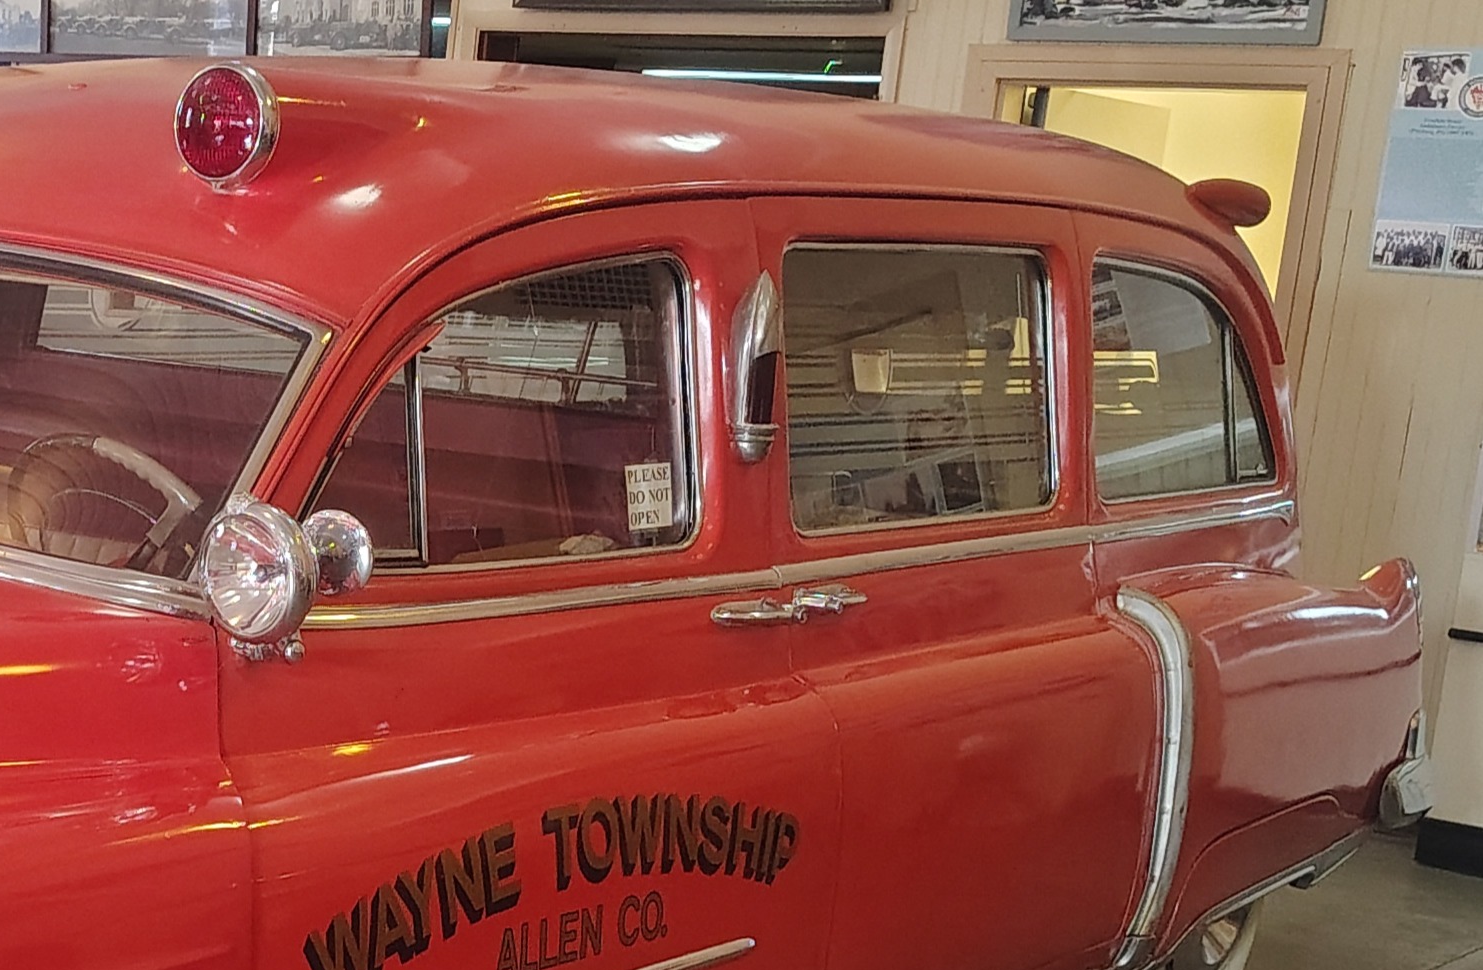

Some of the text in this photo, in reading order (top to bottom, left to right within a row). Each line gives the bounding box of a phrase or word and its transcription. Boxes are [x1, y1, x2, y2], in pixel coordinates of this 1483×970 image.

[627, 465, 670, 484] PLEASE
[628, 487, 671, 505] DO NOT
[630, 509, 660, 527] OPEN
[541, 794, 799, 886] TOWNSHIP
[617, 892, 668, 946] CO.
